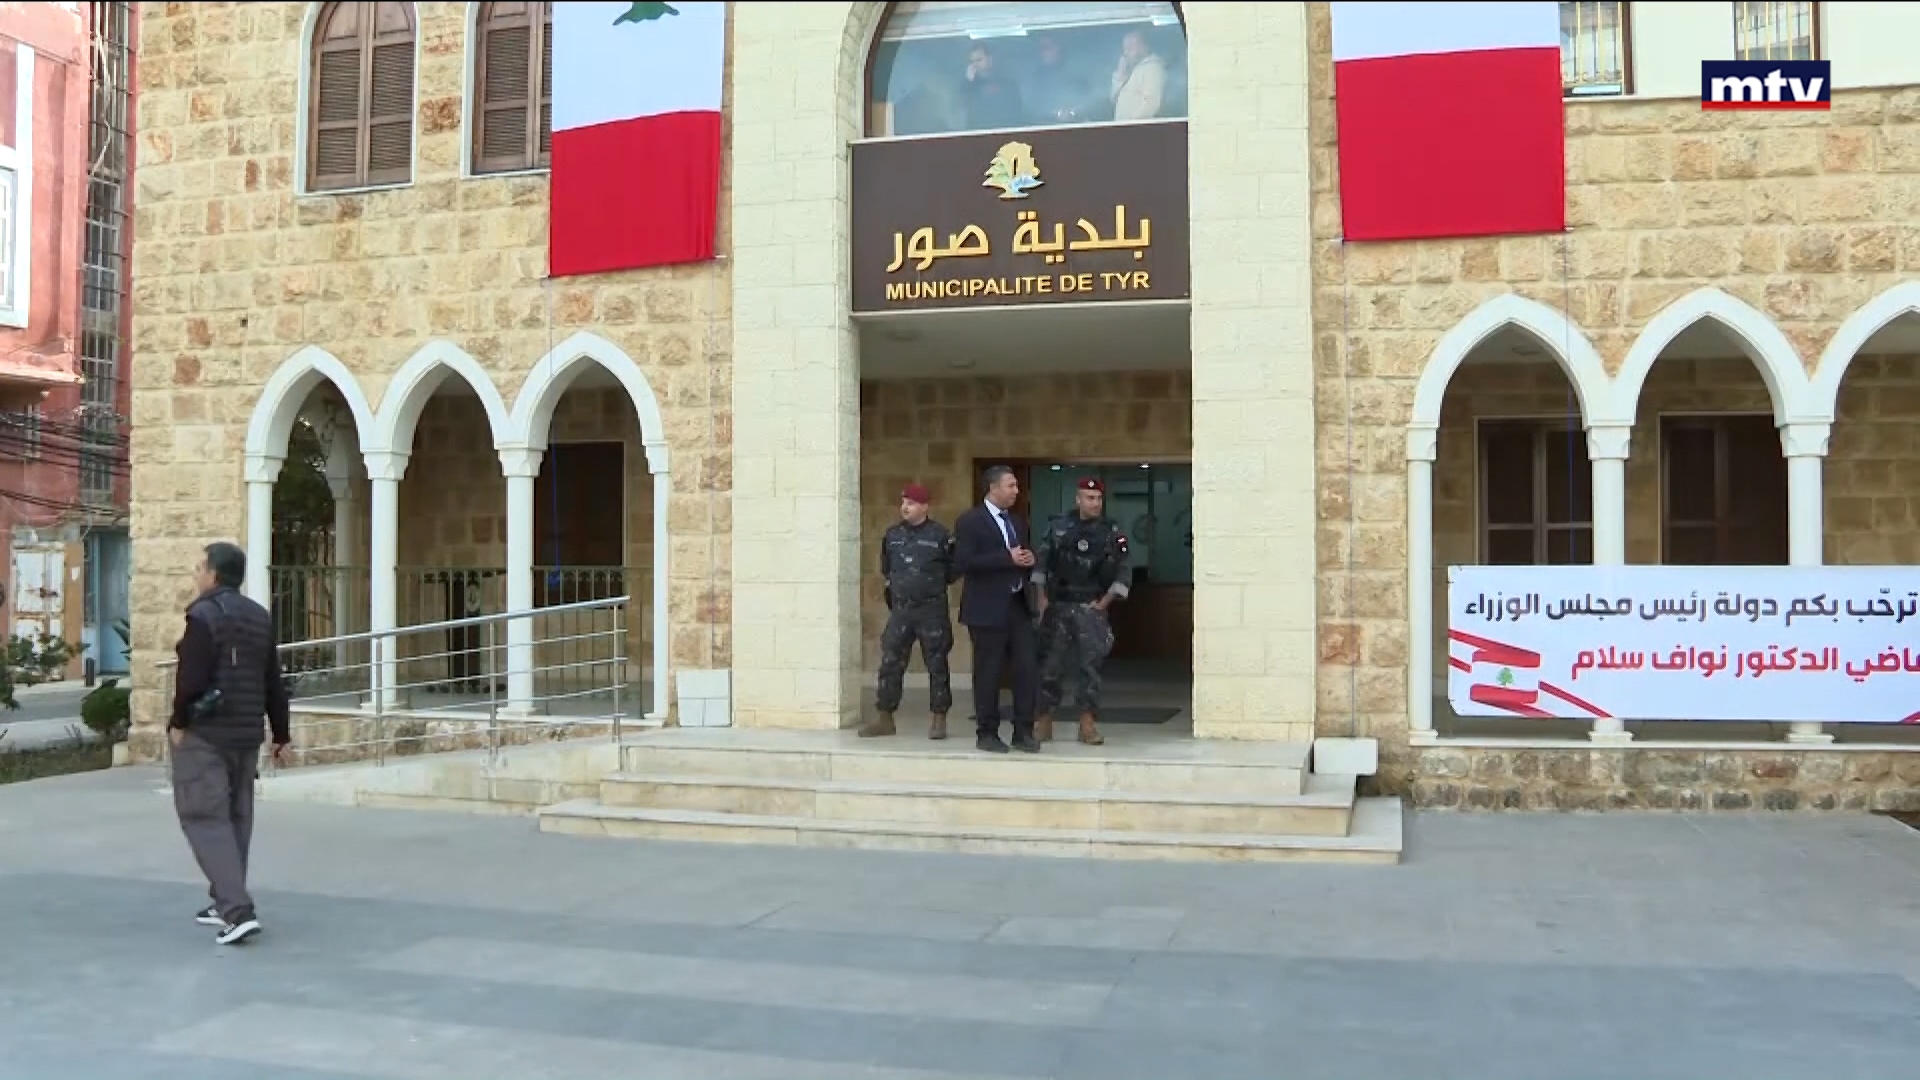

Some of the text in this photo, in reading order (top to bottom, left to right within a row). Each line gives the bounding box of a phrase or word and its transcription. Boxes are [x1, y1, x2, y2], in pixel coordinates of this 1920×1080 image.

[885, 205, 1150, 273] بلدية صور
[885, 270, 1151, 300] MUNICIPALITE DE TYR
[1464, 590, 1540, 622] الوزراء
[1545, 593, 1633, 621] مجلس
[1639, 590, 1707, 623] رئيس
[1713, 591, 1779, 623] دولة
[1785, 593, 1839, 627] بكم
[1571, 645, 1644, 680] سلام
[1652, 645, 1727, 678] نواف
[1734, 645, 1839, 678] الدكتور
